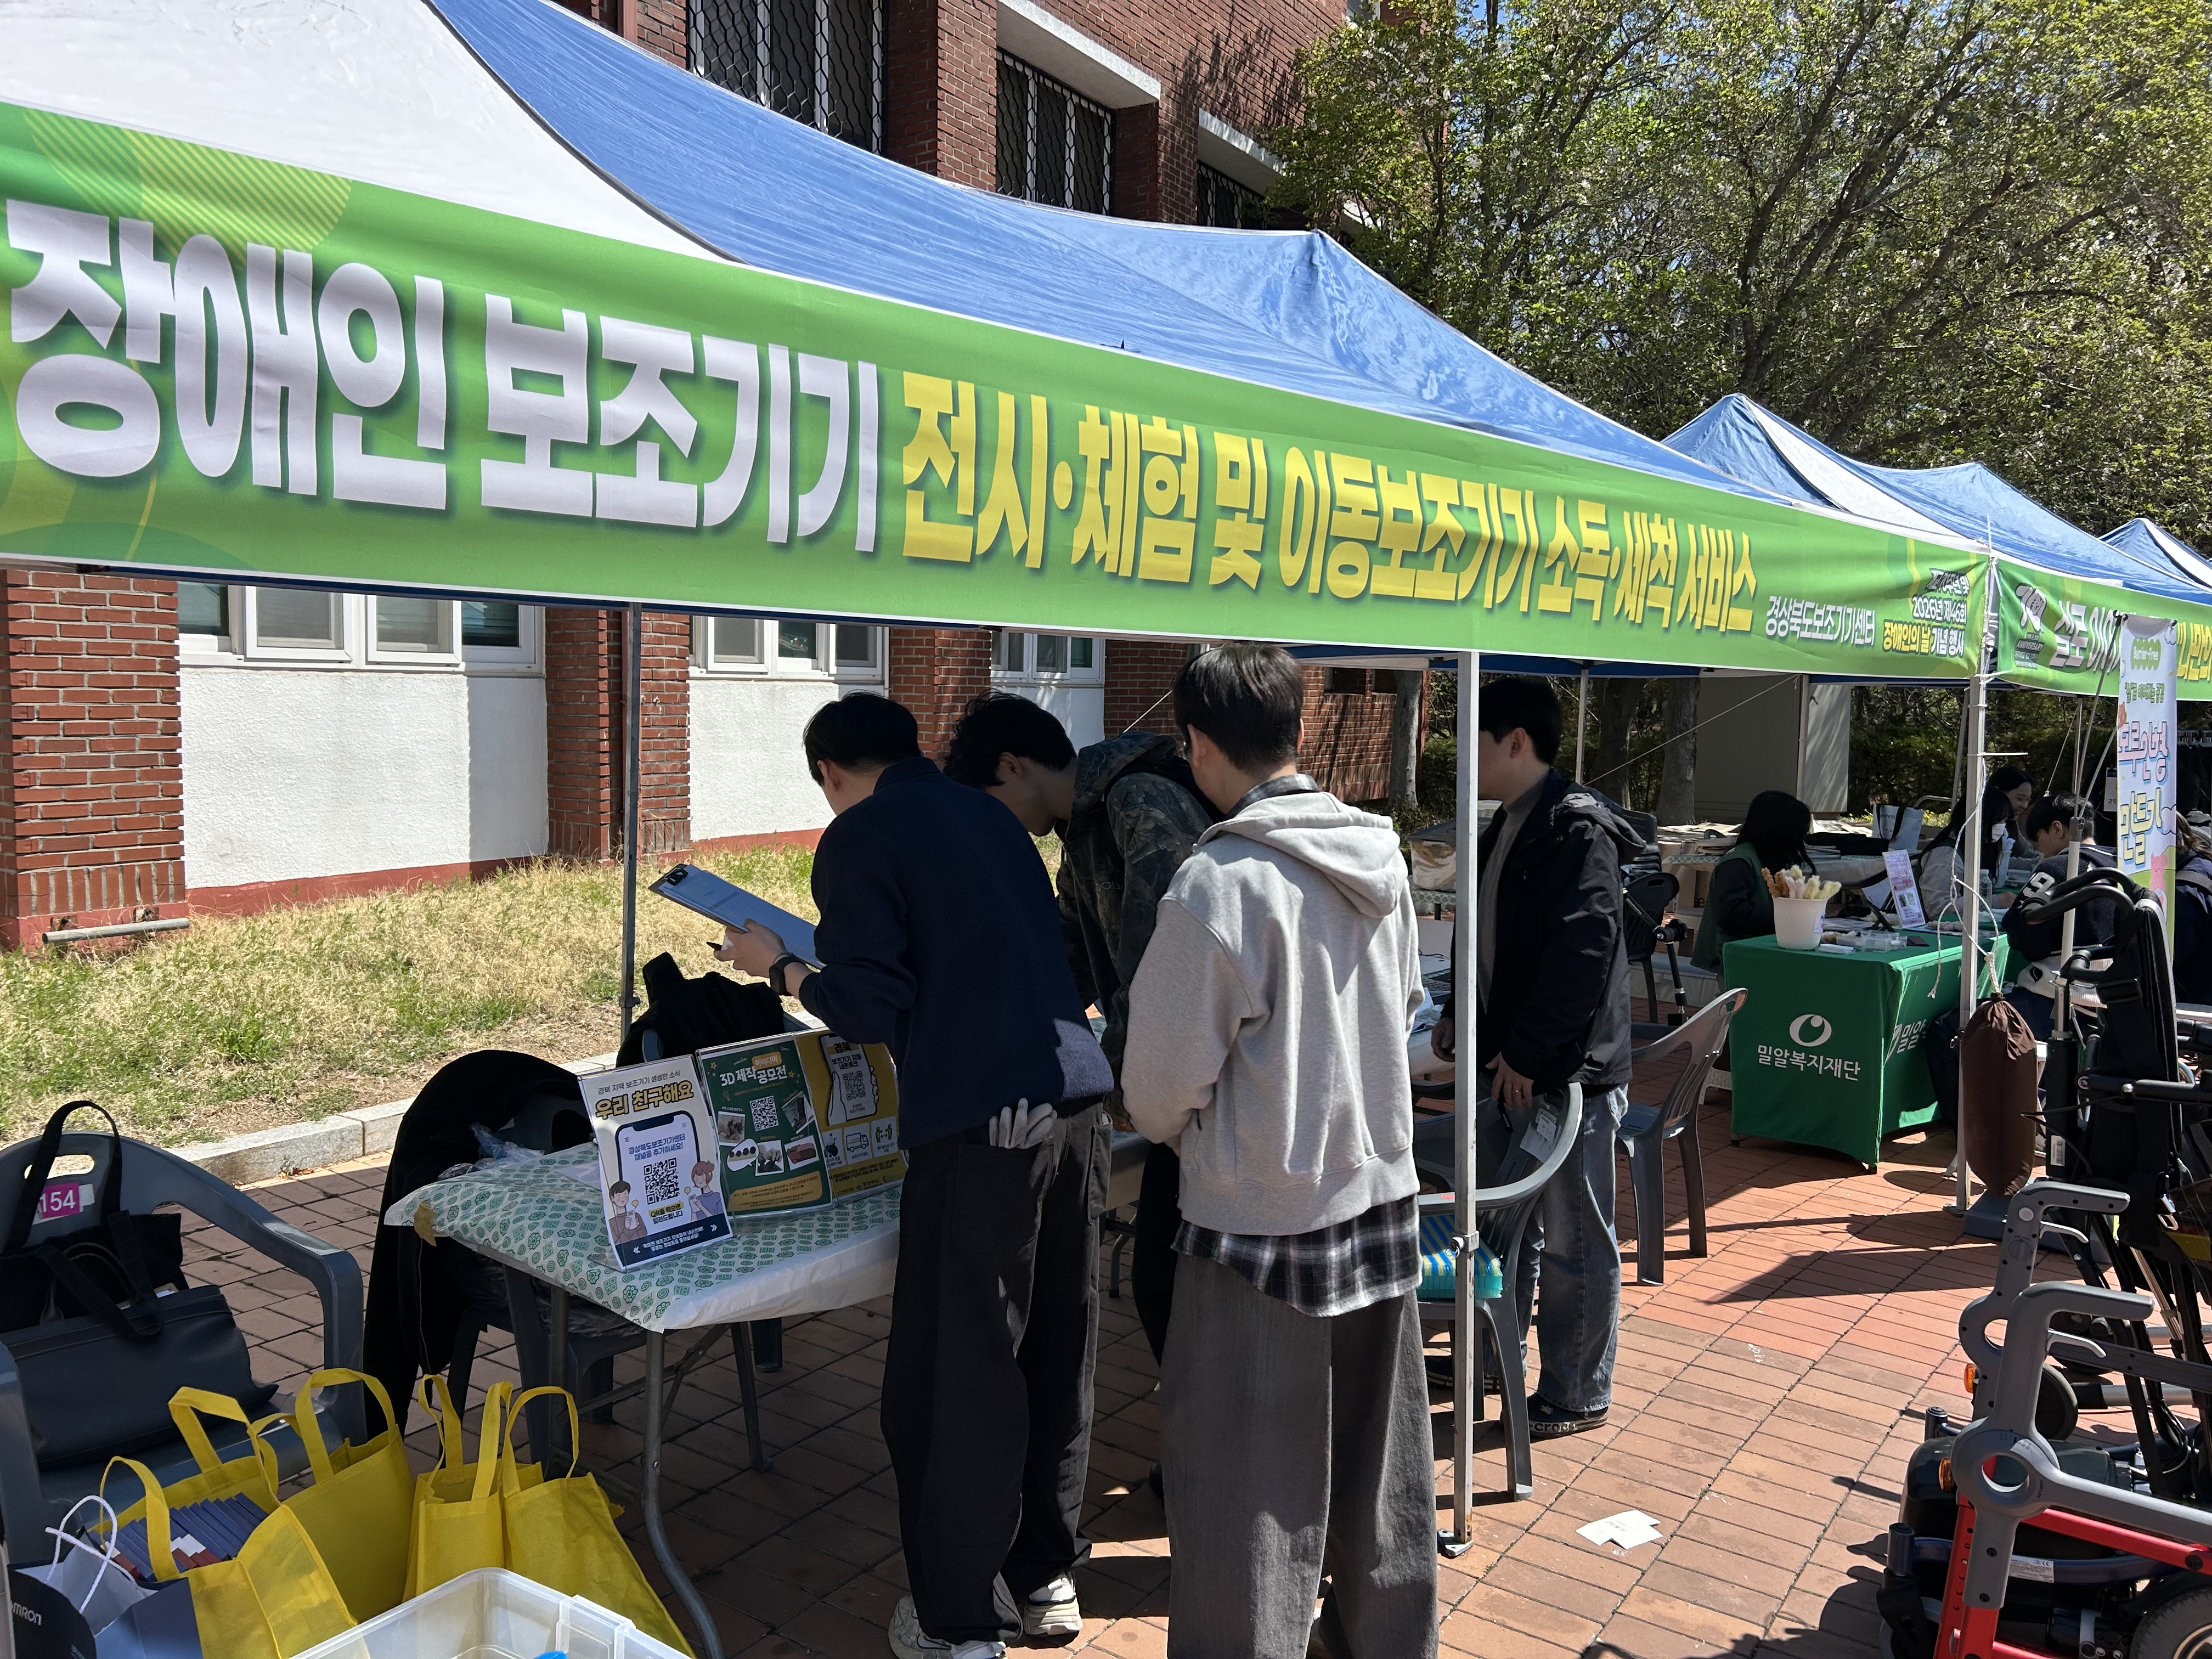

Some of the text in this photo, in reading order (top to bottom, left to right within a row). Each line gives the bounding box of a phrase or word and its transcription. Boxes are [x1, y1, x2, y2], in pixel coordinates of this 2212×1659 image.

[6, 199, 1757, 631] 장애인 보조기기 전시·체험 및 이동보조기기 소독·세척 서비스
[1765, 595, 1875, 646] 경상북도보조기기센터
[1912, 596, 1967, 624] 2026년 제46회
[1883, 622, 1965, 656] 장애인의 날 기념 행사
[2118, 720, 2169, 782] 모루인형
[2120, 787, 2162, 866] 만들기
[719, 1064, 788, 1087] 3D 제작 공모전
[754, 1054, 778, 1066] 아이디어
[1757, 1045, 1861, 1081] 밀알복지재단
[597, 1069, 681, 1095] 경북 지역 보조기기 생생한 소식
[595, 1080, 695, 1120] 우리 친구해요
[628, 1133, 686, 1155] 경상북도보조기기센터
[40, 1189, 76, 1212] 154
